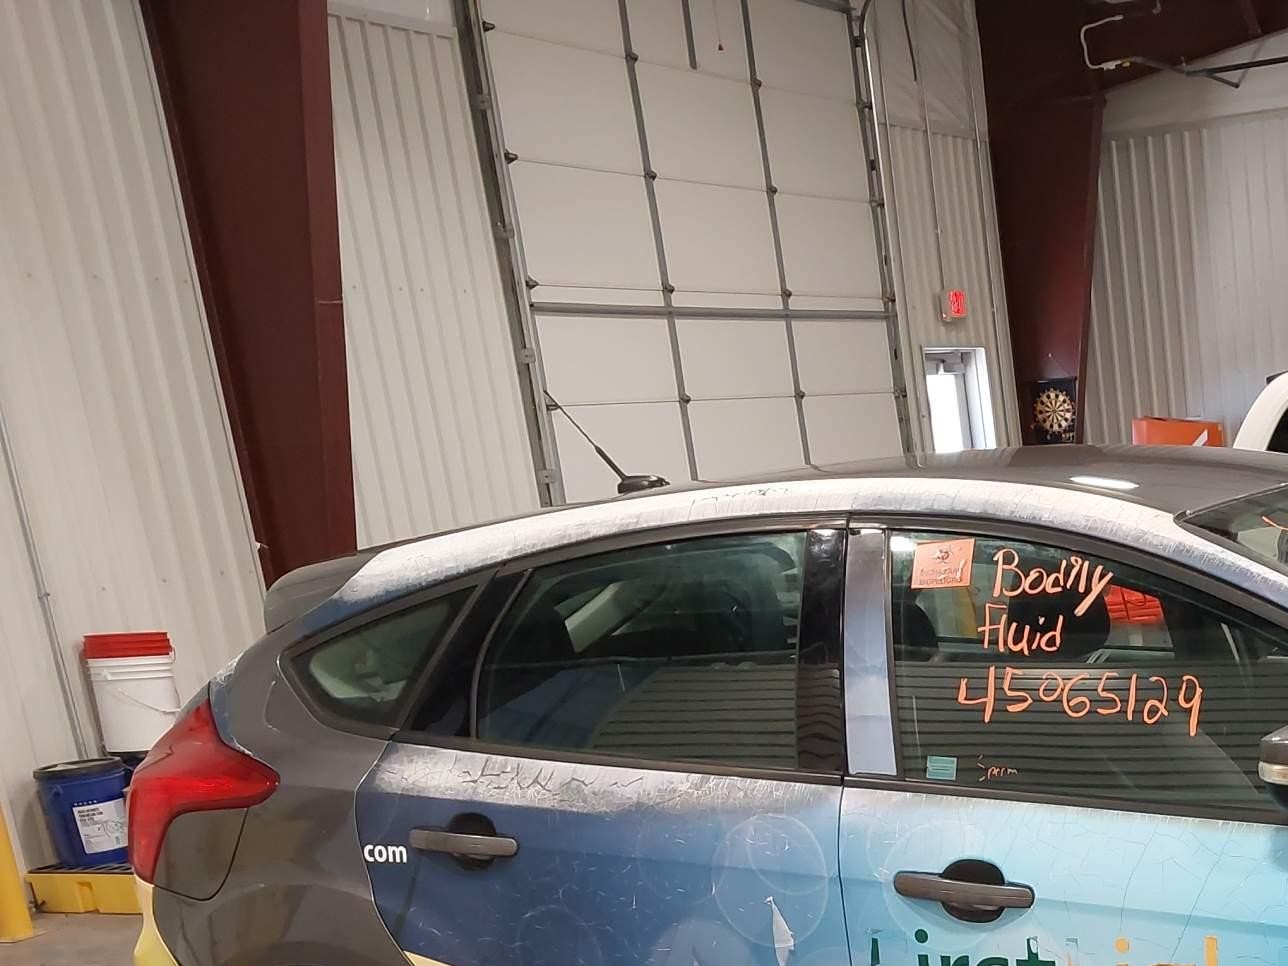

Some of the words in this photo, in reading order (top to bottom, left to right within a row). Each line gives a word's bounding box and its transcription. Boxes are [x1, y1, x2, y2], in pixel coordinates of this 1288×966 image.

[993, 549, 1114, 616] Bodily
[977, 602, 1064, 656] Fluid
[957, 665, 1203, 737] 45065129
[363, 844, 408, 863] com
